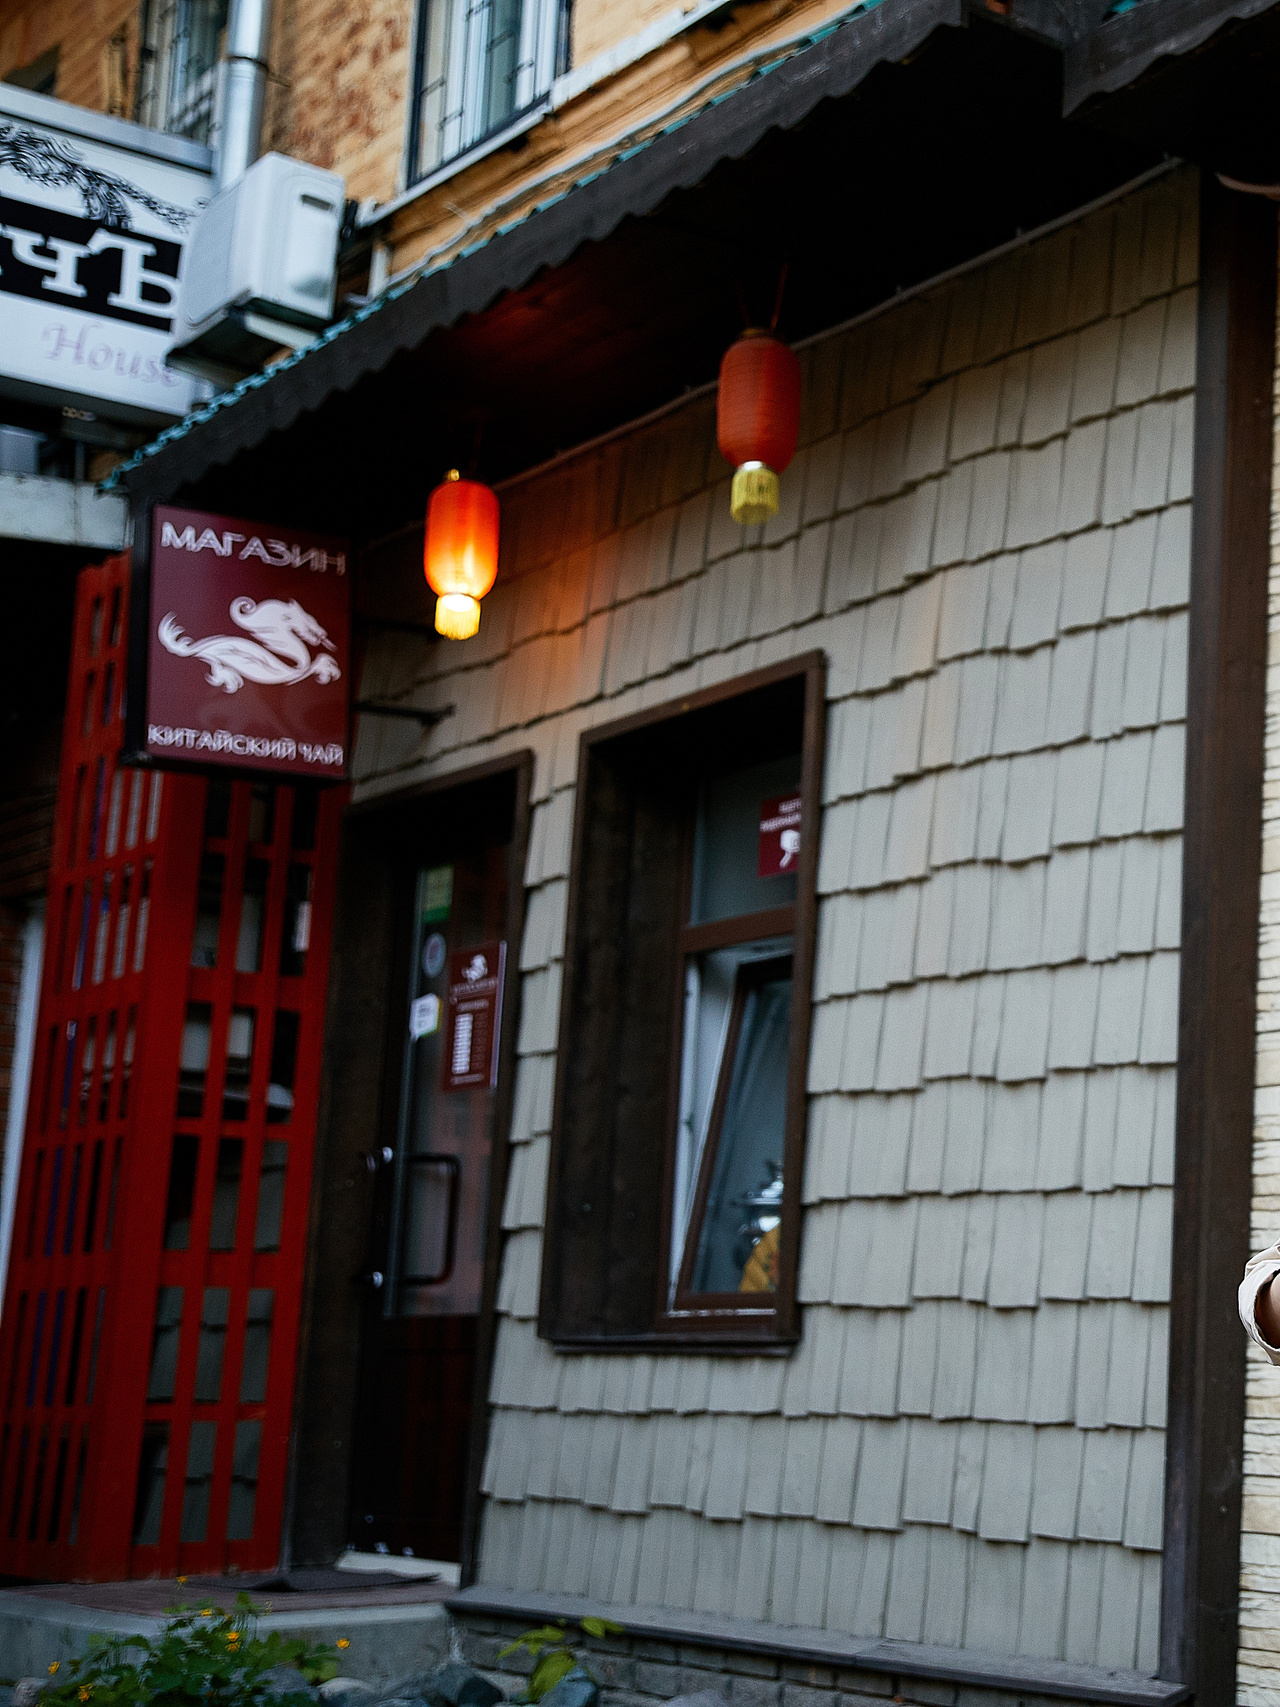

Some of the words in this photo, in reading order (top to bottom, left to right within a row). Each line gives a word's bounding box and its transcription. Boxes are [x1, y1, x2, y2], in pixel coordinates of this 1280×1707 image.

[0, 224, 181, 319] ЧЪ
[161, 521, 346, 576] МАГАЗИН
[147, 724, 296, 760] КИТАЙСКИЙ
[299, 742, 344, 766] ЧАЙ
